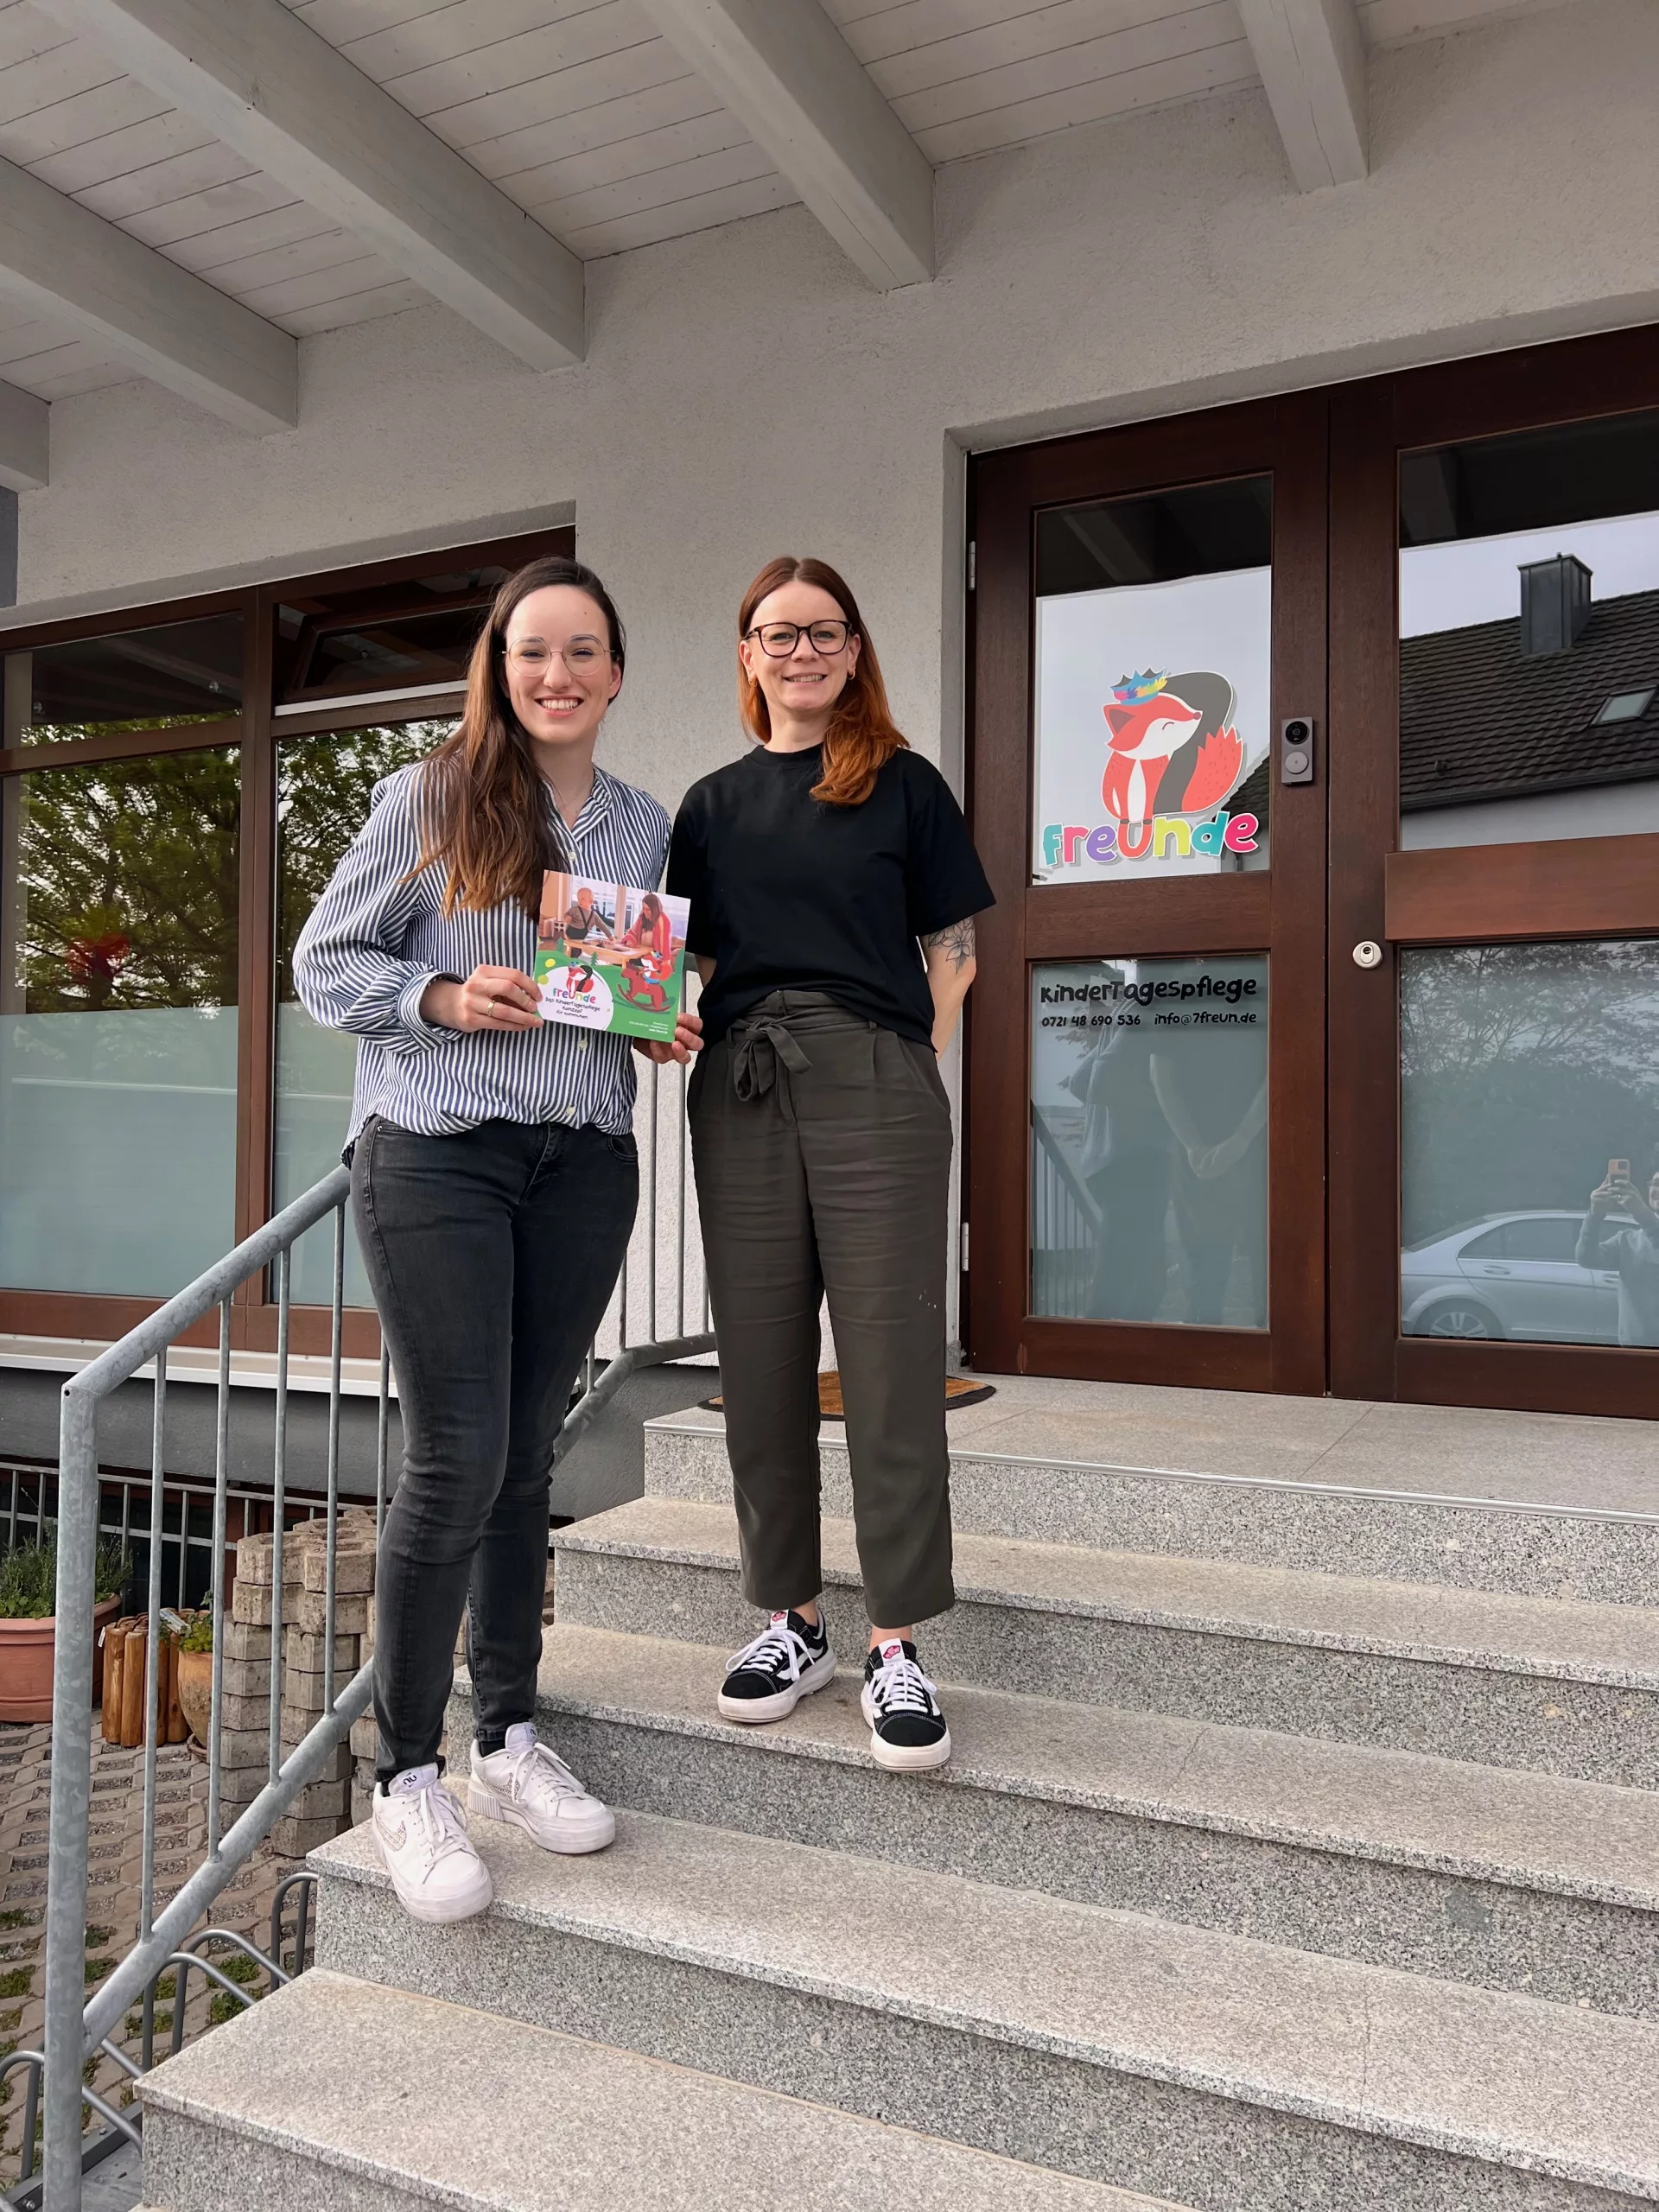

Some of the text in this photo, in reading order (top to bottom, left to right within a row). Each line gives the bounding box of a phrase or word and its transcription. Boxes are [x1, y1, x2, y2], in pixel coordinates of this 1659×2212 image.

[1041, 1011, 1257, 1027] 0721 48 690 536 info@7freun.de
